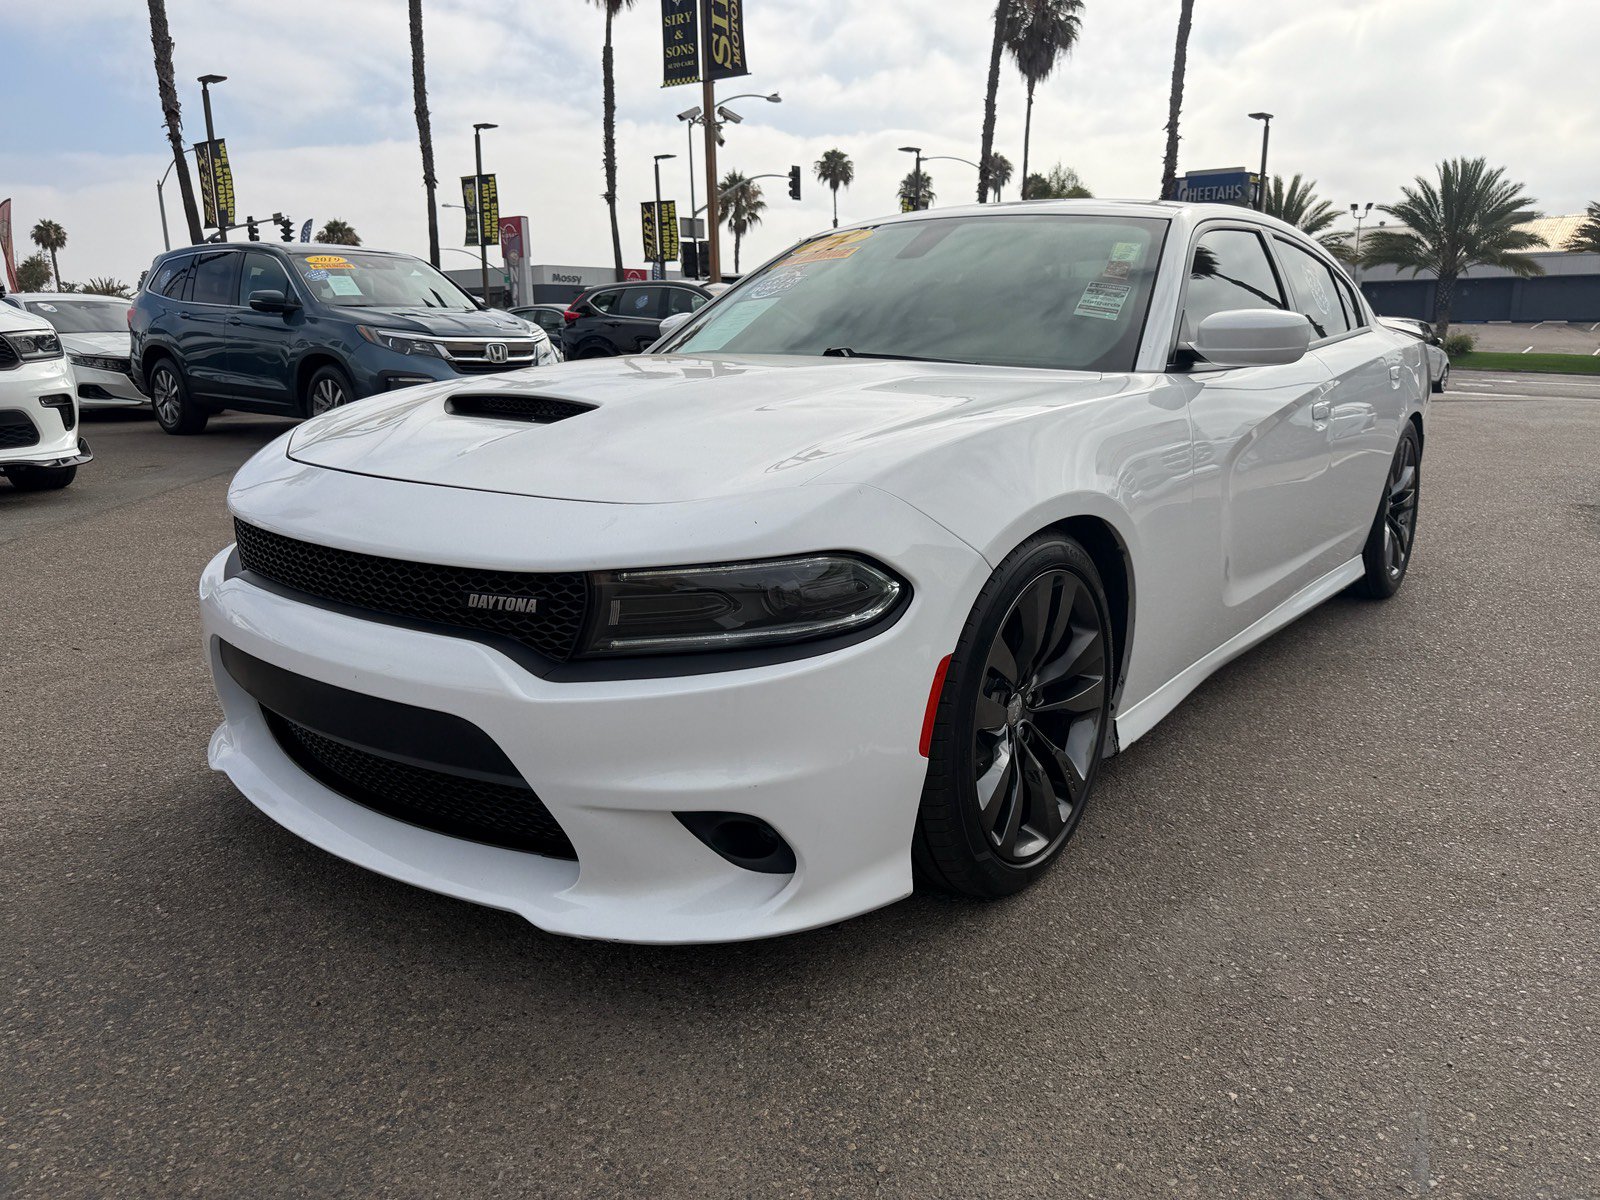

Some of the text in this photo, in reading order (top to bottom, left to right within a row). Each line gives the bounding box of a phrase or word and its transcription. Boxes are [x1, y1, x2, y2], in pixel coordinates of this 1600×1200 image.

[664, 11, 692, 27] SIRY
[674, 29, 684, 40] &
[711, 0, 732, 69] SI
[730, 0, 741, 67] MOTO
[665, 43, 695, 58] SONS
[214, 157, 228, 211] ANYONE
[218, 142, 235, 224] WE FINANCE
[482, 183, 491, 238] AUTO CARE
[488, 175, 498, 244] FULL SERVICE
[661, 203, 671, 260] OUR TROOPS
[668, 202, 678, 259] WE SUPPORT
[552, 273, 581, 284] Mossy
[468, 594, 537, 613] DAYTONA
